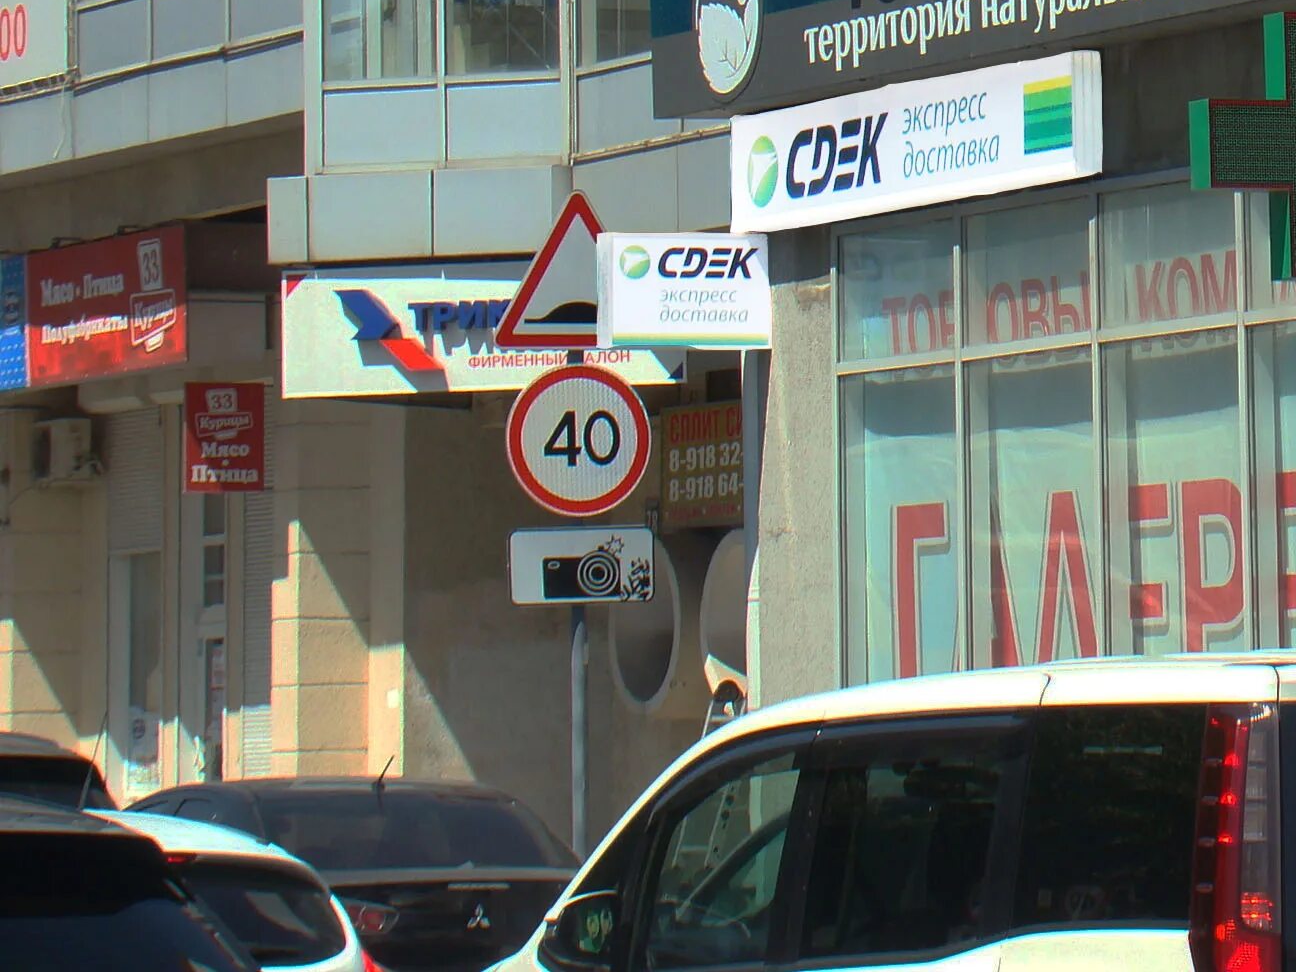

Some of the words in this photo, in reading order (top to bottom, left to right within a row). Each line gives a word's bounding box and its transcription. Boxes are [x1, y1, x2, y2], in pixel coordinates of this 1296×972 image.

[902, 90, 988, 136] экспресс
[785, 111, 889, 200] CDEK
[902, 132, 1000, 179] доставка
[142, 246, 161, 286] 33
[657, 246, 760, 280] CDEK
[40, 278, 74, 307] Мясо
[83, 272, 125, 300] Птица
[659, 288, 738, 307] экспресс
[659, 305, 749, 324] доставка
[583, 349, 632, 365] АЛОН
[211, 393, 233, 410] 33
[201, 441, 250, 459] Мясо
[543, 409, 622, 467] 40
[669, 443, 716, 473] 8-918
[192, 464, 259, 485] Птица
[669, 474, 714, 503] 8-918
